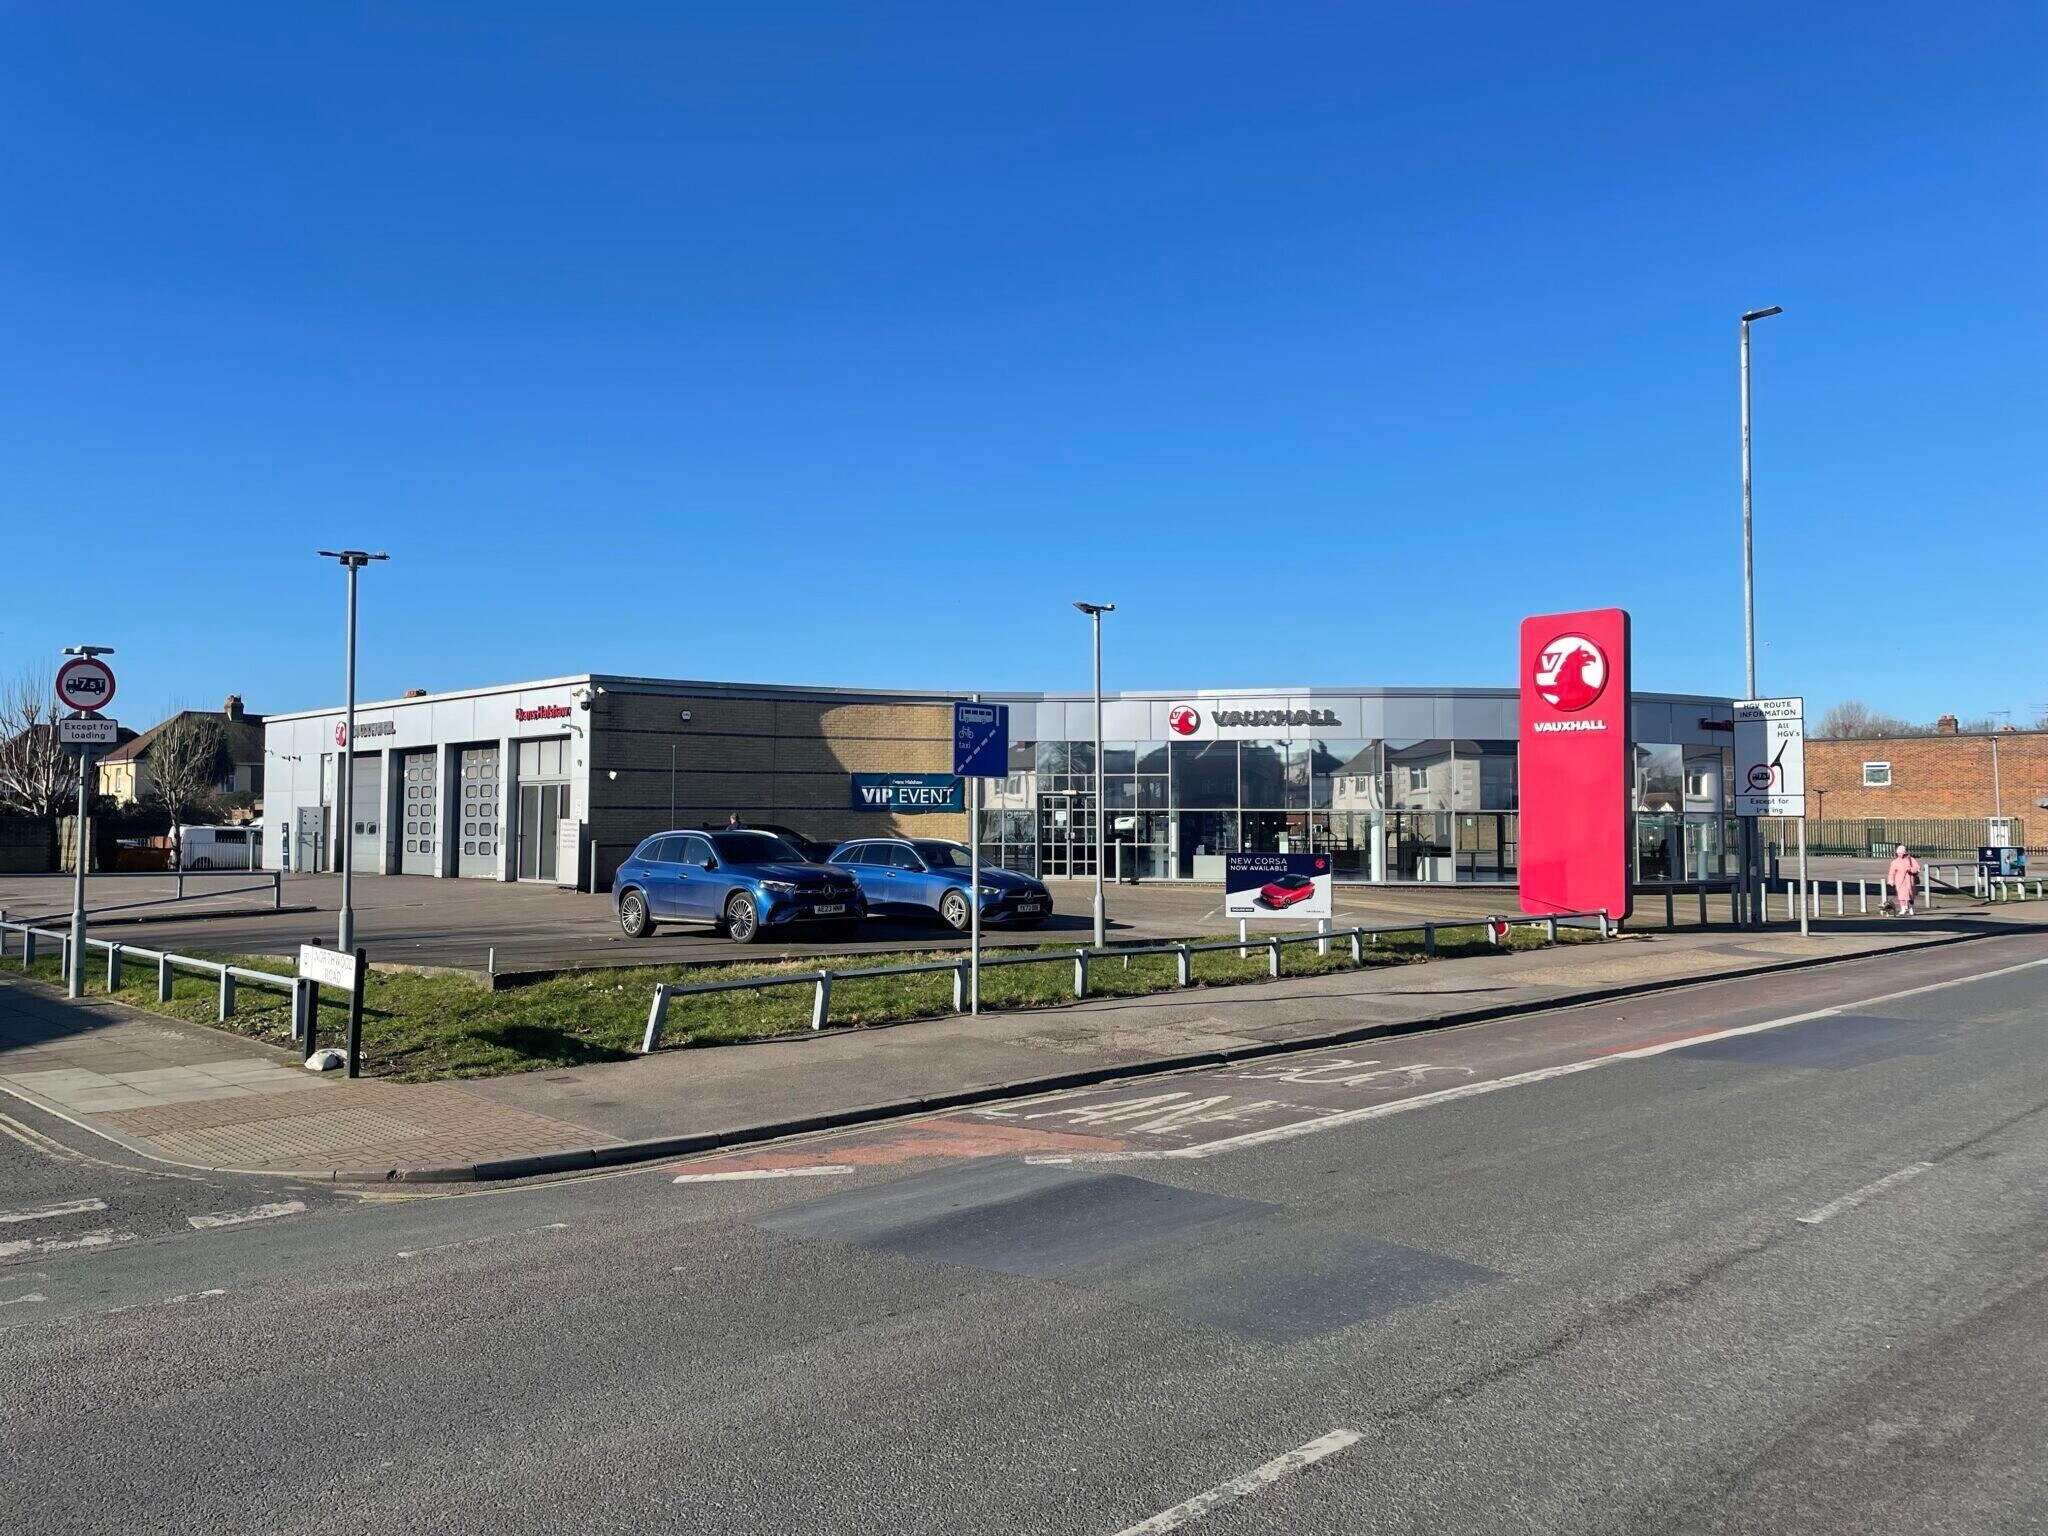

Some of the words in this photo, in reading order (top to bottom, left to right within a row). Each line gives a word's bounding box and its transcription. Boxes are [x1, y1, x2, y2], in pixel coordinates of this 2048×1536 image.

[1211, 709, 1342, 727] VAUXHALL
[1739, 709, 1796, 718] INFORMATION
[64, 722, 97, 731] Except
[100, 723, 113, 731] for
[1533, 719, 1607, 732] VAUXHALL
[71, 731, 106, 740] loading
[958, 741, 971, 749] taxi
[861, 788, 893, 803] VIP
[899, 788, 954, 803] EVENT
[1750, 797, 1775, 806] Except
[1230, 857, 1252, 865] NEW
[1254, 857, 1288, 865] CORSA
[313, 950, 355, 971] NORTHWOOD
[324, 968, 342, 984] ROAD
